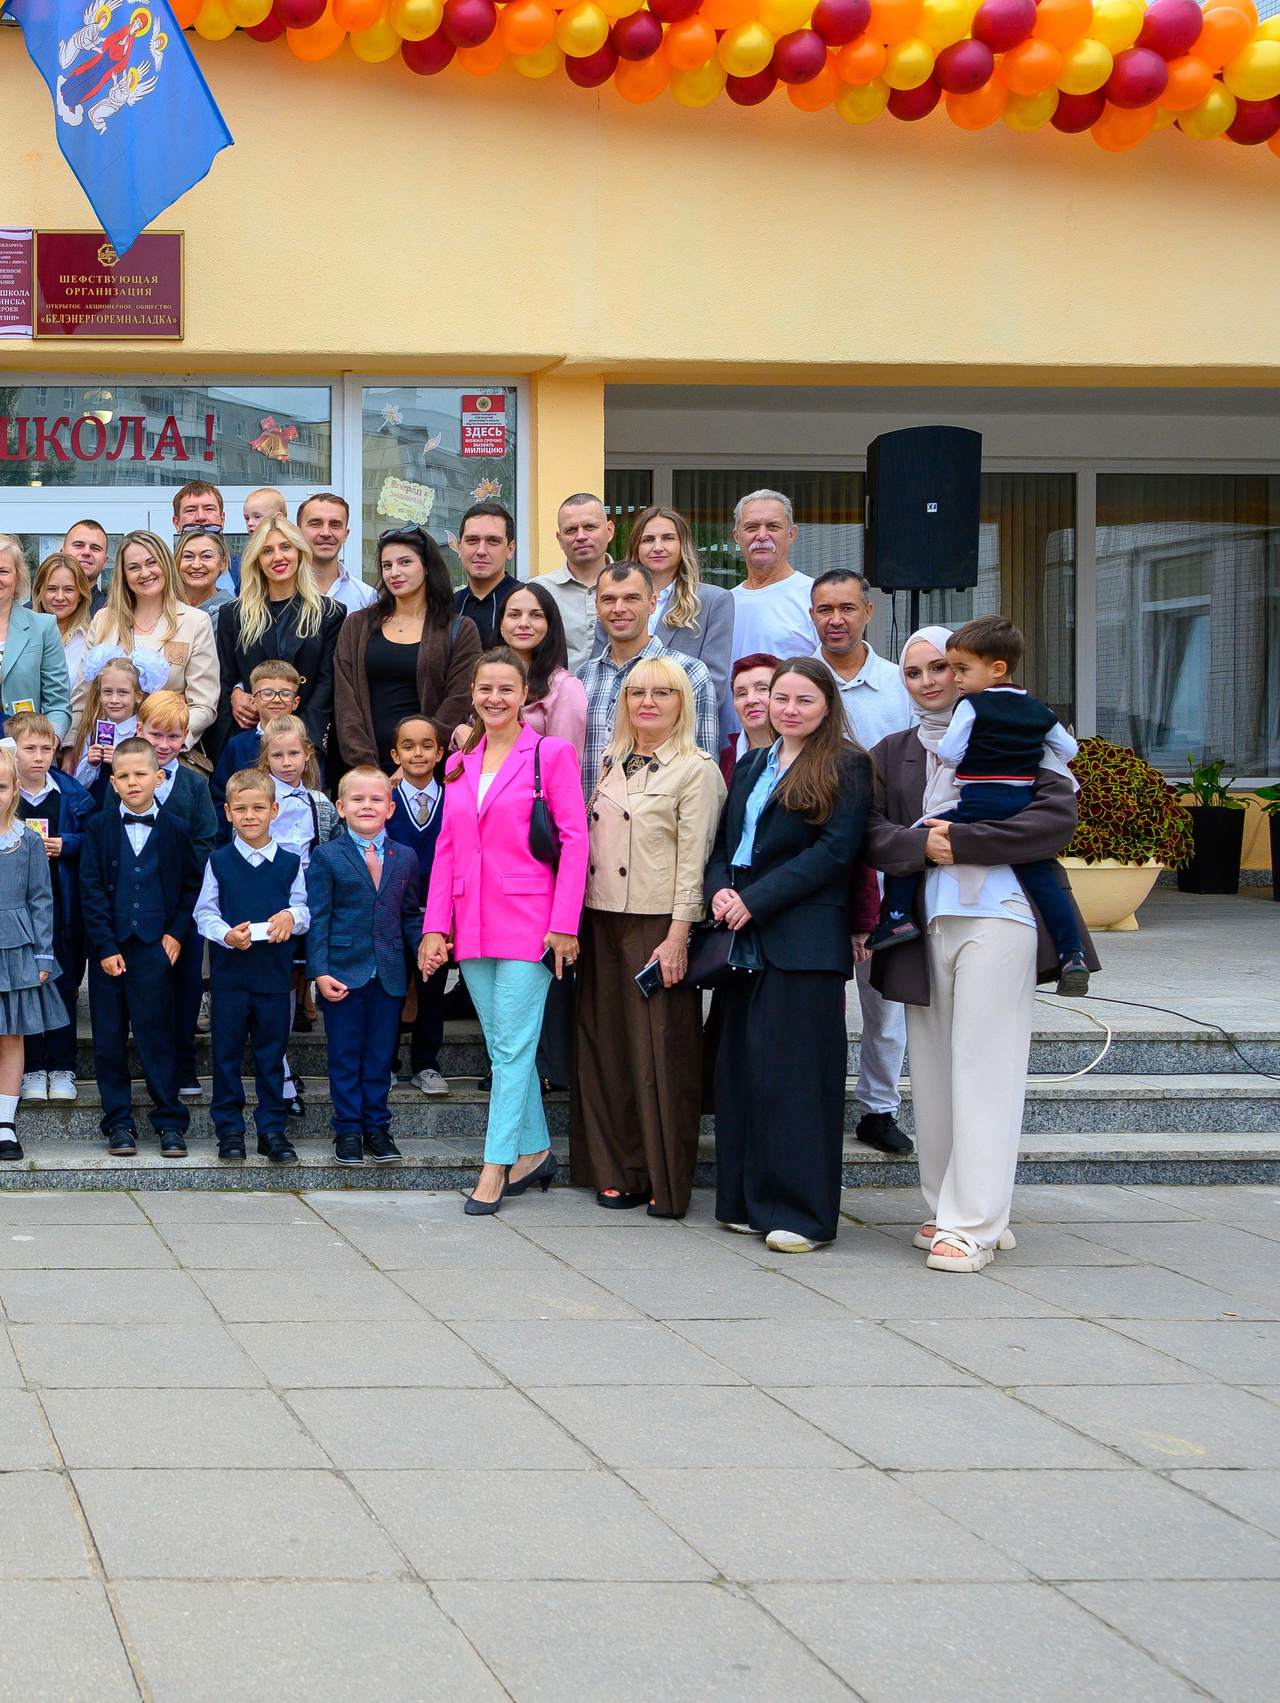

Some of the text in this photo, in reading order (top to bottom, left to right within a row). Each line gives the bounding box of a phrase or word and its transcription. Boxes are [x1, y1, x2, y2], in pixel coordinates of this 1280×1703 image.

[59, 275, 159, 284] ШЕФСТВУЮЩАЯ
[65, 287, 152, 297] ОРГАНИЗАЦИЯ
[40, 314, 178, 325] «БЕЛЭНЕРГОРЕМНАЛАДКА»
[465, 426, 503, 439] ЗДЕСЬ
[464, 447, 504, 455] МИЛИЦИЮ
